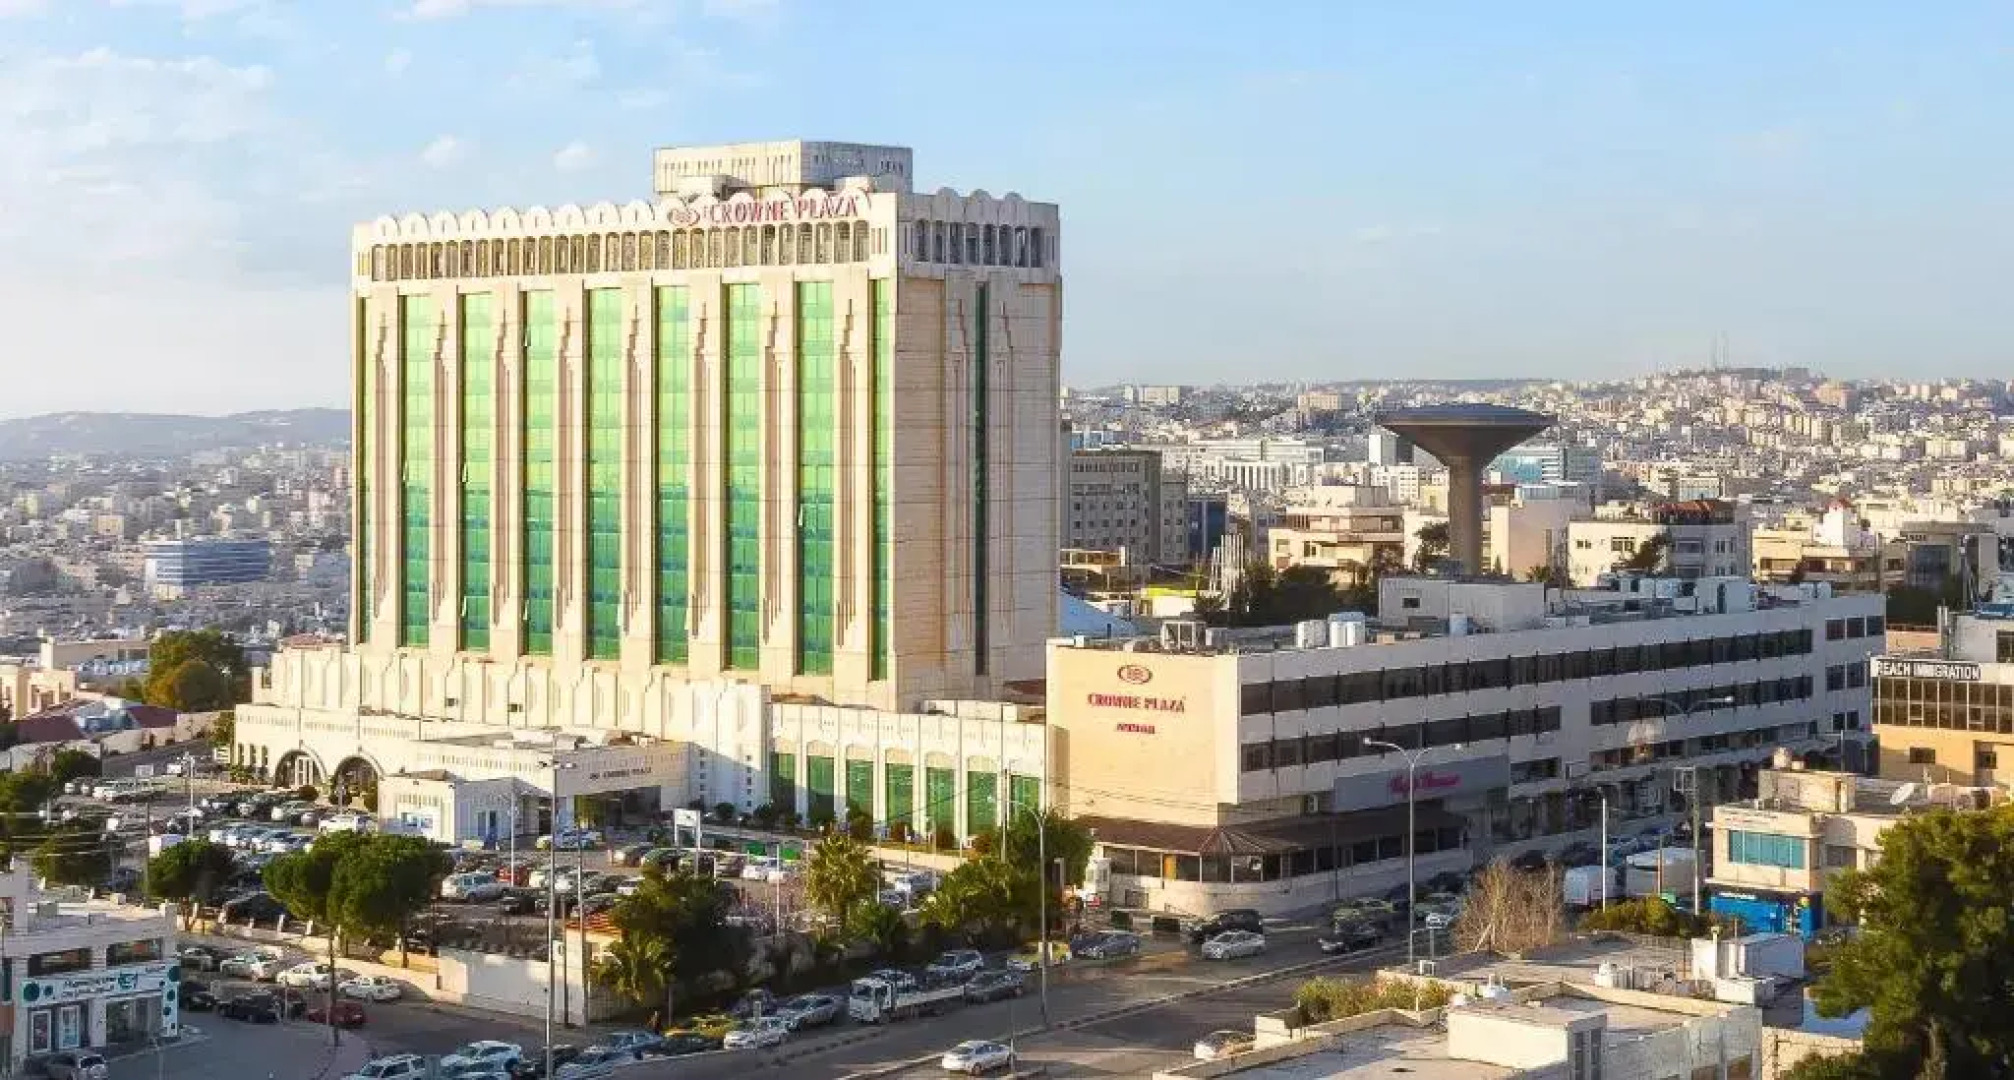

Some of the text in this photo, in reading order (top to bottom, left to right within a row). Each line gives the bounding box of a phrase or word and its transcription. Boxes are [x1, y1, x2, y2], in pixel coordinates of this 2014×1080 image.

[709, 195, 858, 224] CROWNE PLAZA
[1877, 662, 1980, 680] REACH IMMIGRATION
[1087, 693, 1185, 713] CROWNE PLAZA
